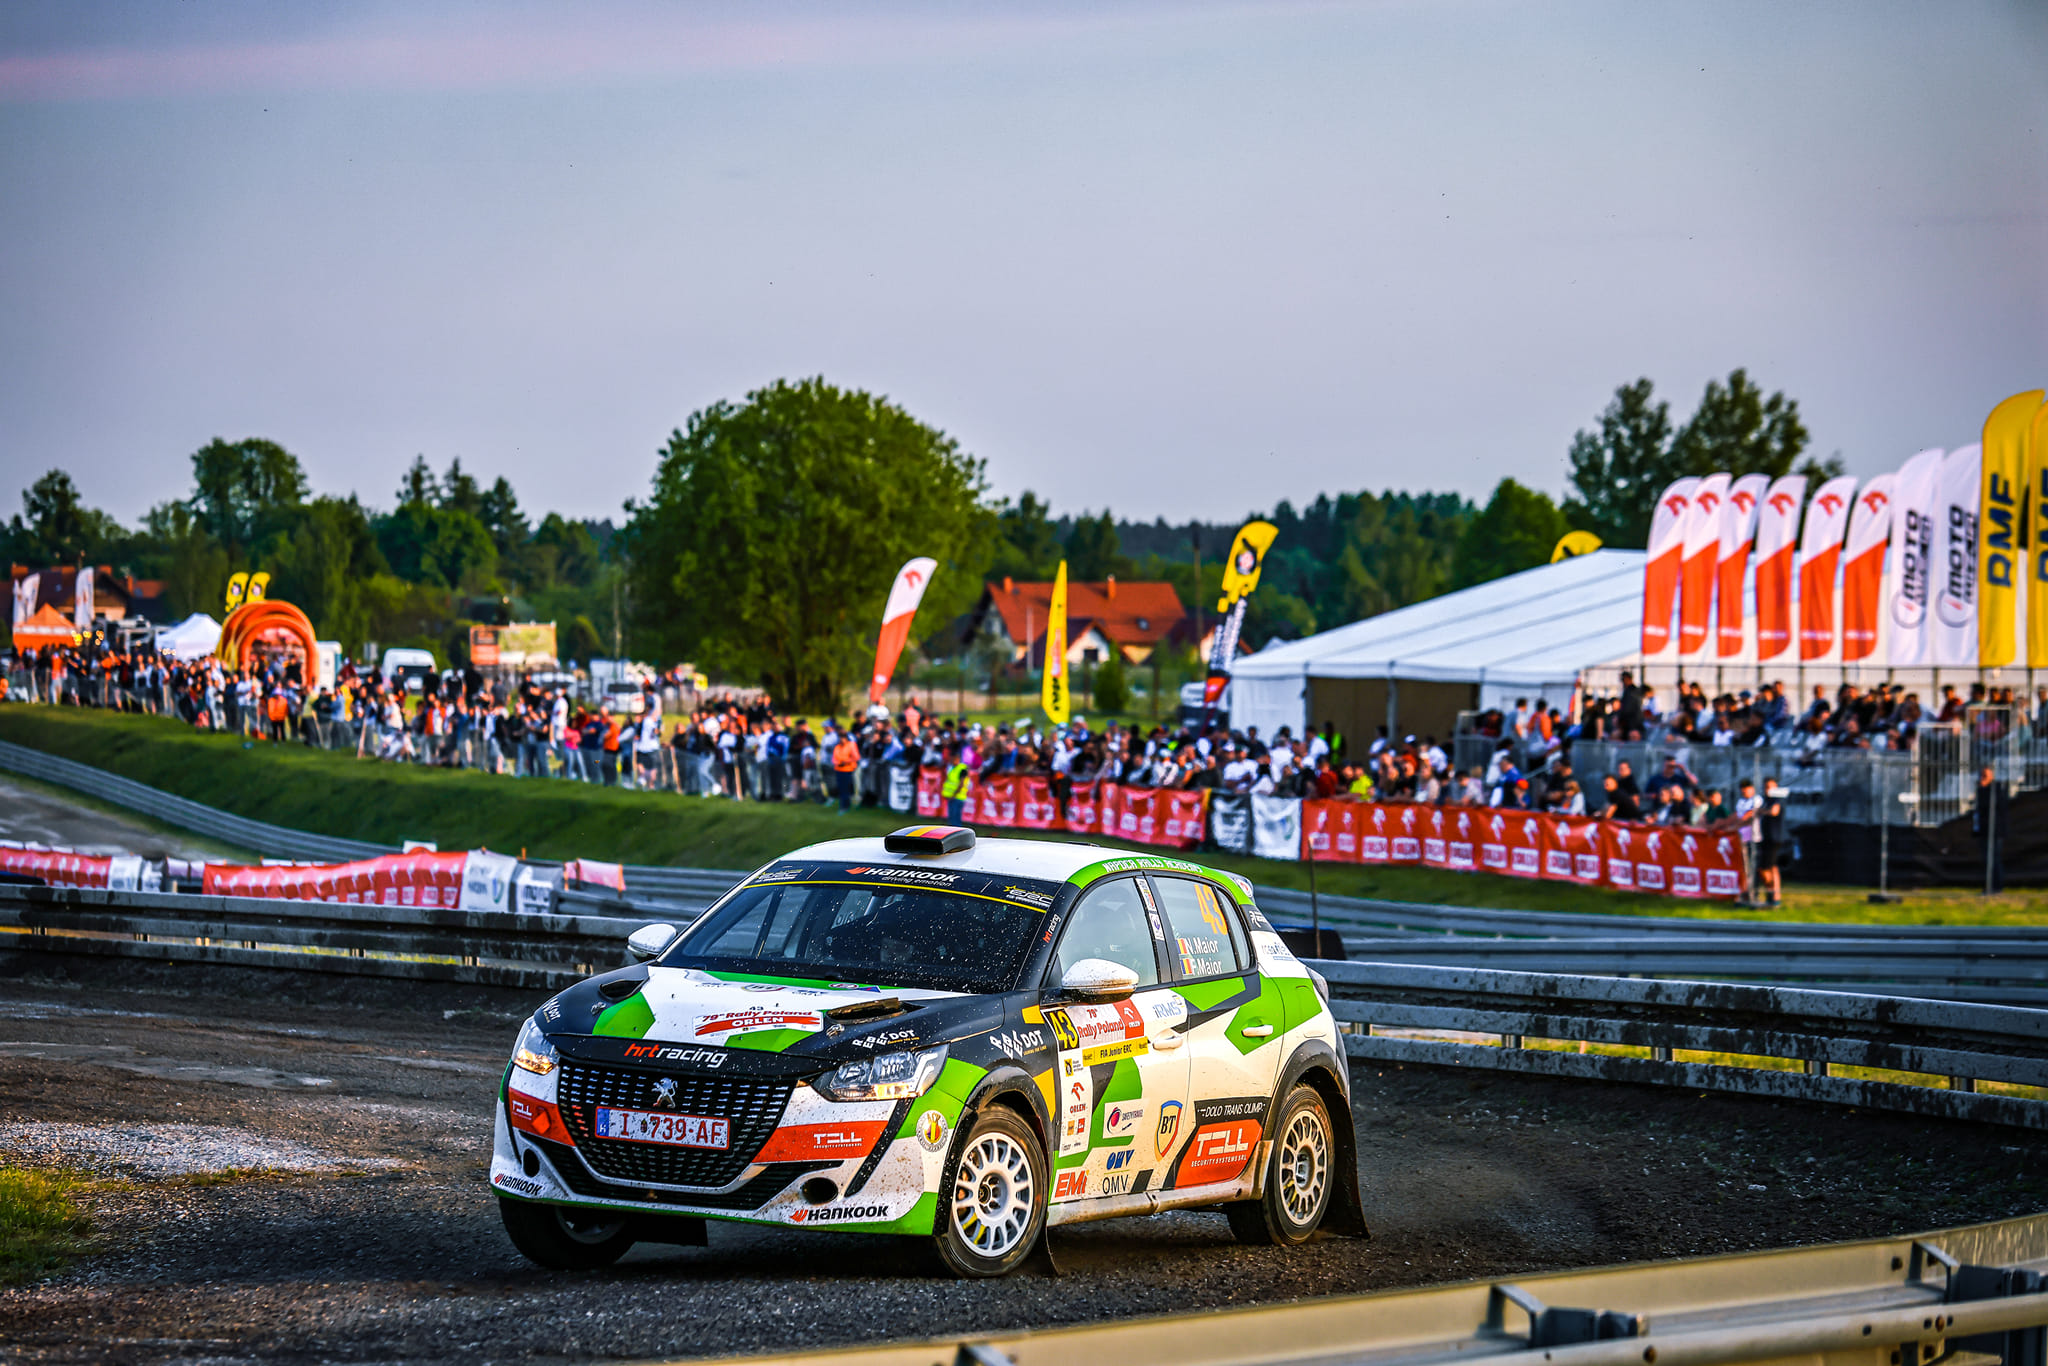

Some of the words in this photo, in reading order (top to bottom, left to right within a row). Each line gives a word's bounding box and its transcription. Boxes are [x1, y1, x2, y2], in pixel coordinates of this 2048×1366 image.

[1102, 860, 1138, 873] NAPOCA
[1136, 858, 1164, 868] RALLY
[881, 876, 913, 884] driving
[914, 879, 951, 887] emotion
[1193, 884, 1228, 936] 43
[726, 1010, 762, 1018] Rally
[731, 1016, 784, 1027] ORLEN
[1049, 1010, 1079, 1050] 43
[1077, 1023, 1097, 1040] Rally
[1097, 1018, 1125, 1035] Poland
[1100, 1049, 1108, 1059] FIA
[1108, 1046, 1123, 1057] Junior
[1123, 1044, 1132, 1054] ERC
[1070, 1104, 1086, 1113] ORLEN
[1204, 1105, 1223, 1117] DOLO
[1224, 1103, 1243, 1115] TRANS
[1160, 1115, 1176, 1134] BT
[1197, 1128, 1249, 1157] TELL
[1191, 1157, 1215, 1167] SECURITY
[1215, 1155, 1238, 1164] SYSTEMS
[1102, 1175, 1129, 1195] OMV
